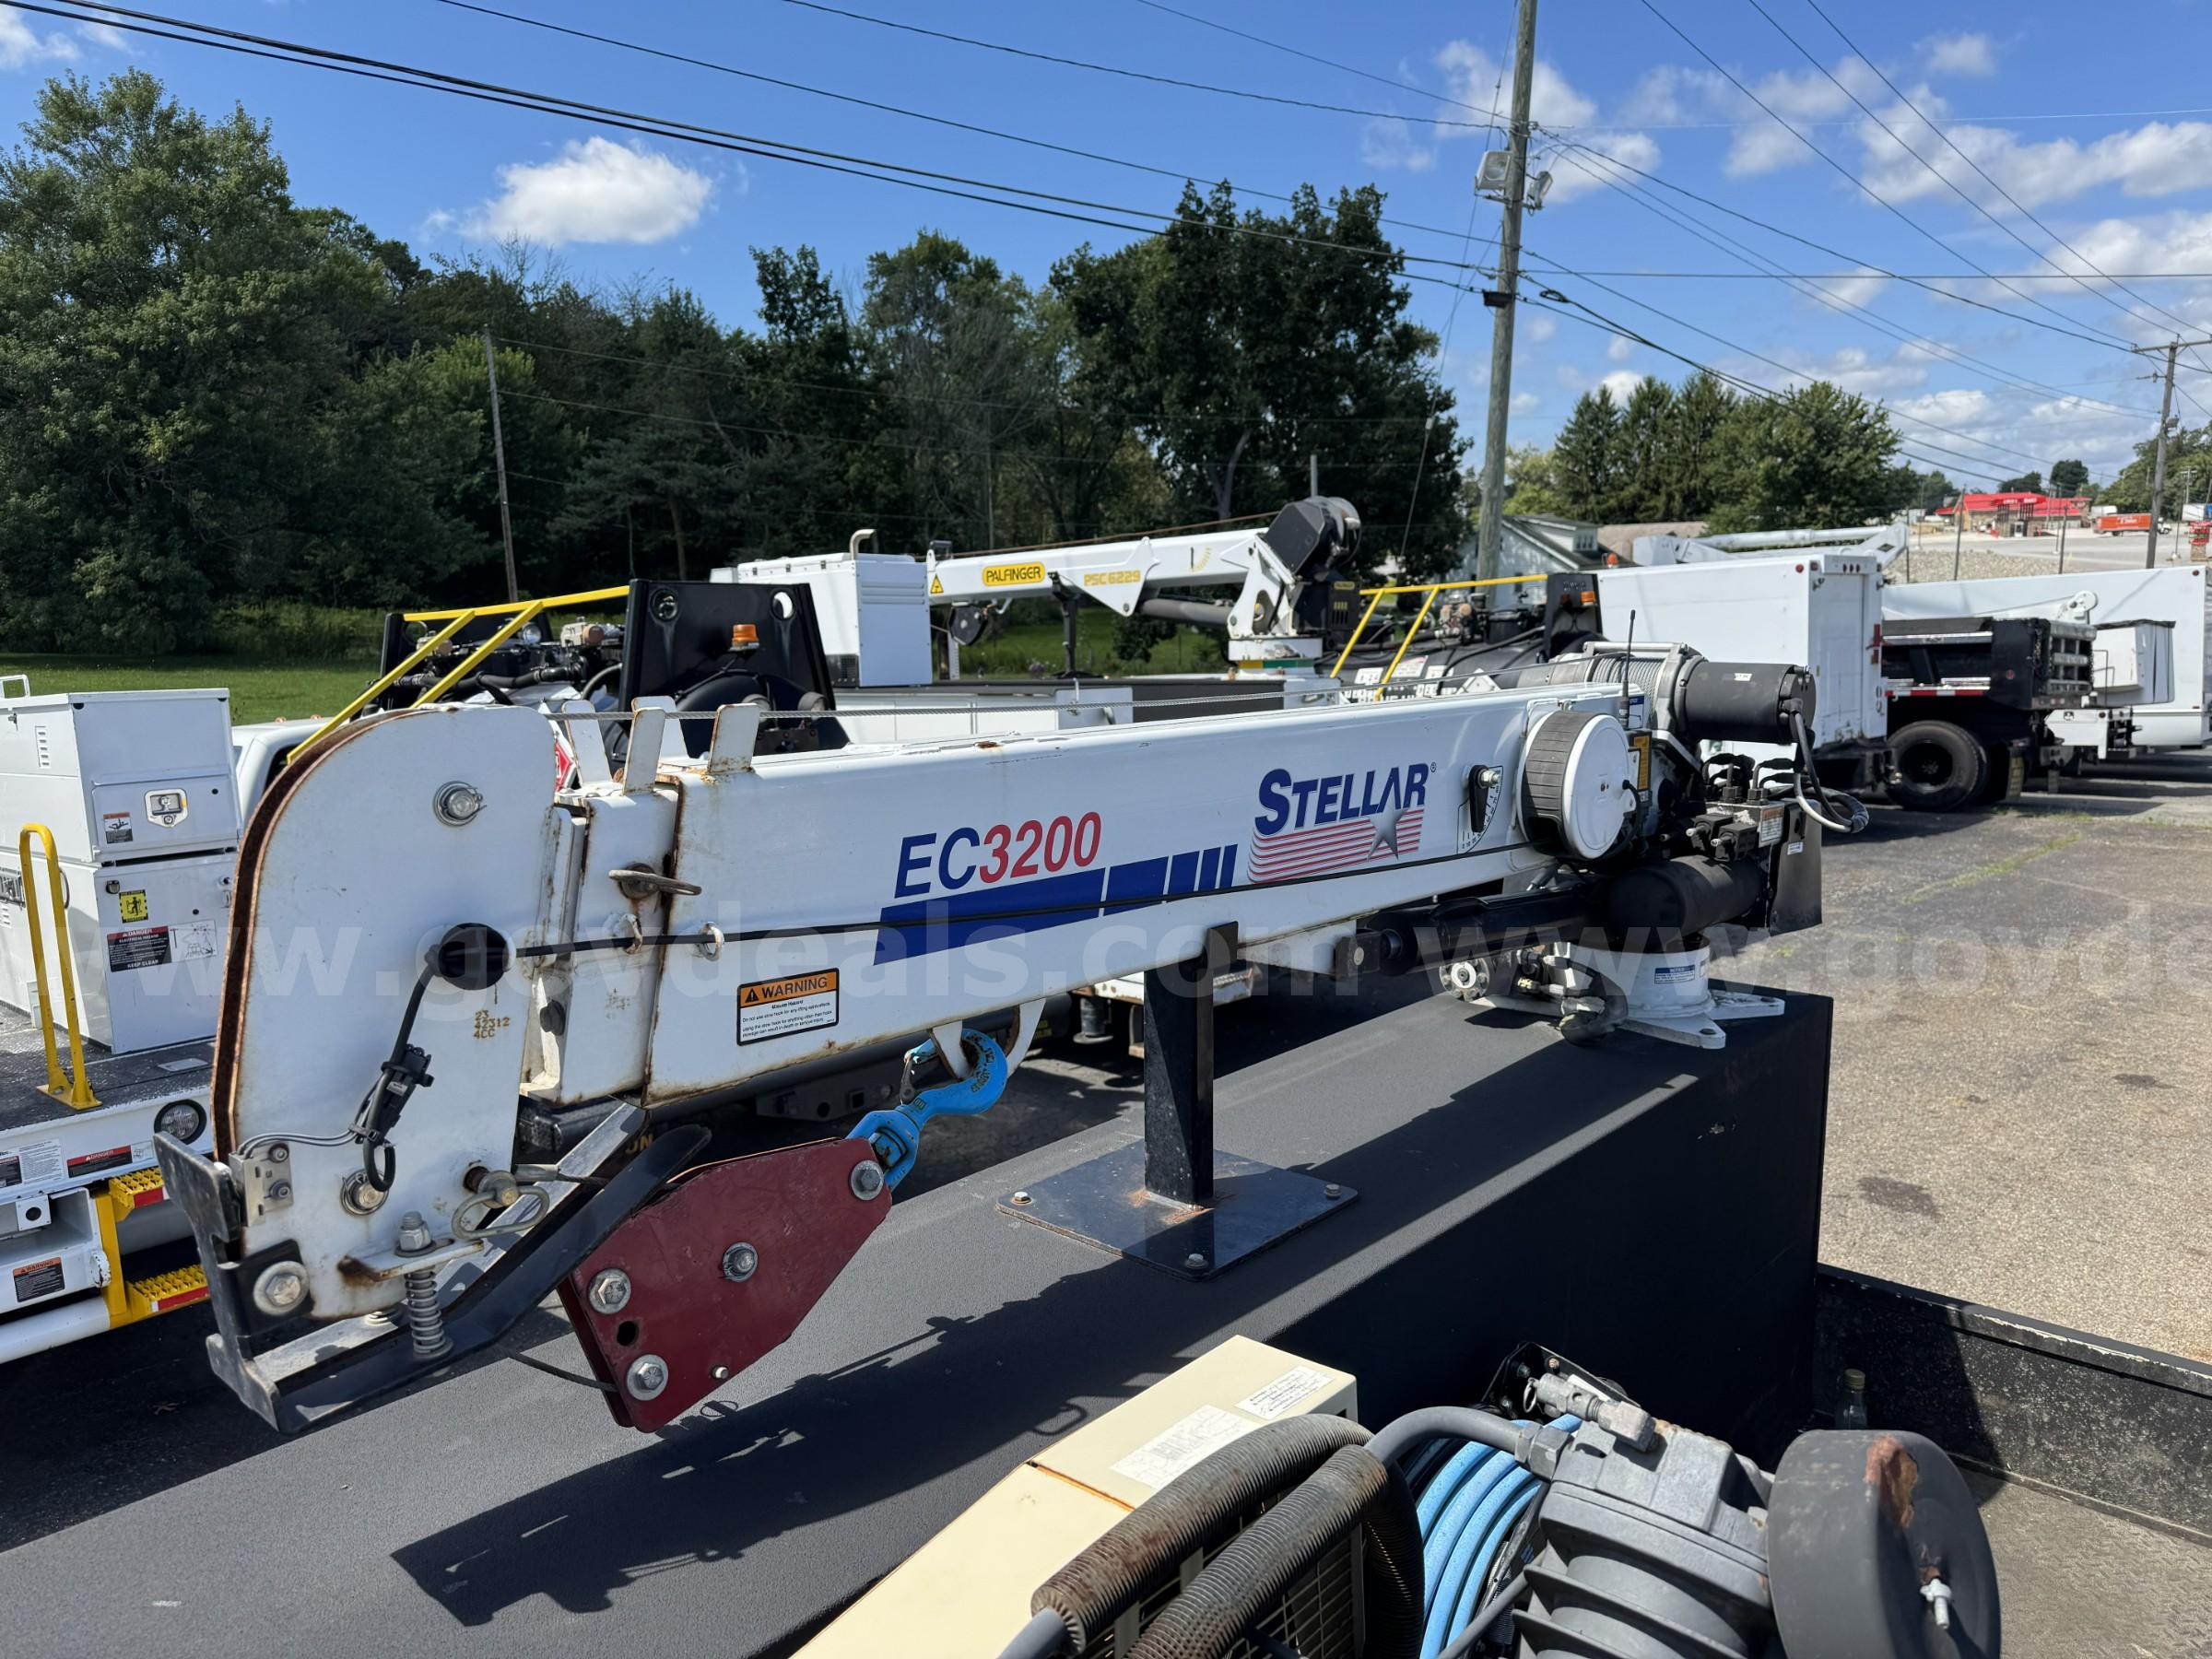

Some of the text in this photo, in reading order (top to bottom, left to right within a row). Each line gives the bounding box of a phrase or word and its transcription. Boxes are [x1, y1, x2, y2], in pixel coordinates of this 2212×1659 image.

[986, 566, 1041, 582] PALFINGER
[1254, 763, 1429, 835] STELLAR
[894, 811, 1101, 899] EC3200
[762, 977, 827, 999] WARNING
[475, 1009, 489, 1020] 23
[475, 1017, 510, 1029] 42312
